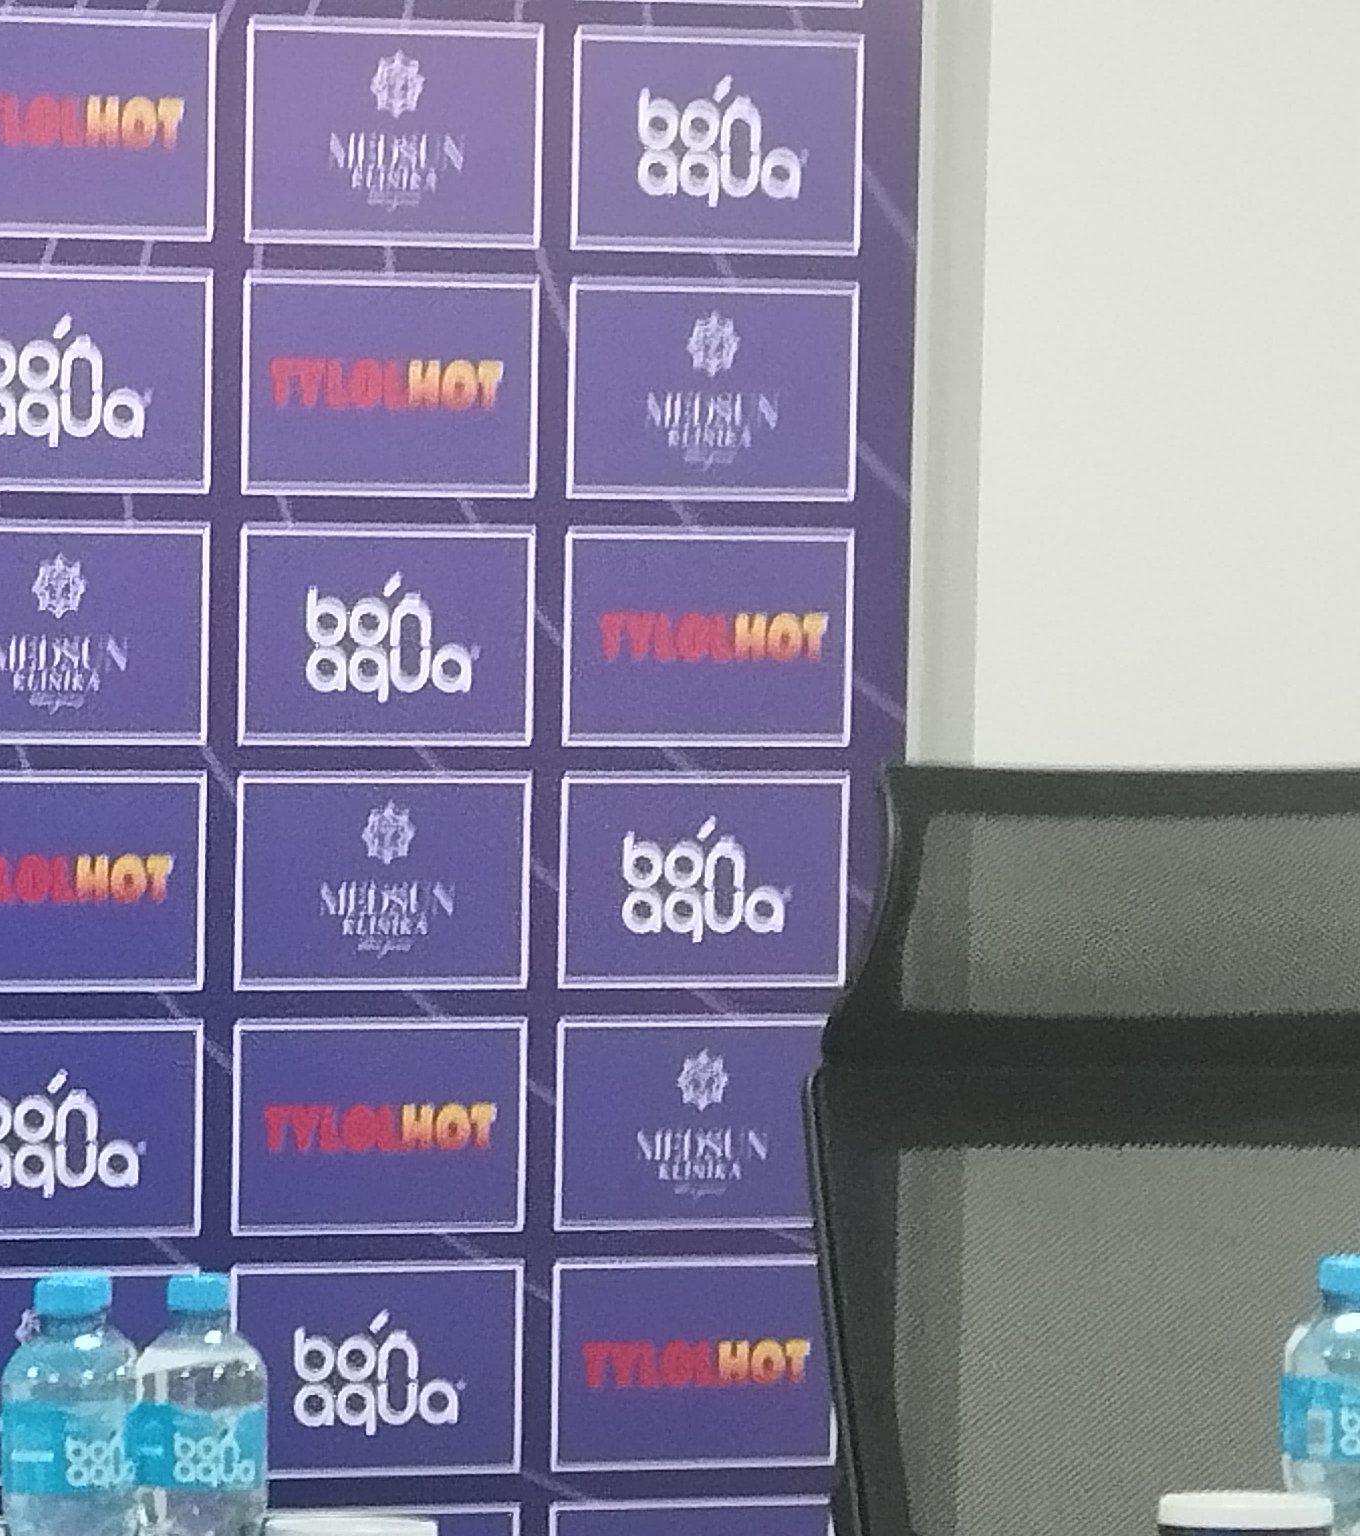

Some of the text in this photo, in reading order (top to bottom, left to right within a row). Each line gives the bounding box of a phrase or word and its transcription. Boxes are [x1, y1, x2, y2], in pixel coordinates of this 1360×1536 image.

[638, 75, 761, 151] bón
[638, 149, 803, 207] aqua
[306, 571, 431, 647] bón
[306, 646, 474, 703] aqua
[622, 816, 745, 891] bón
[622, 888, 786, 943] aqua
[294, 1309, 418, 1383] bón
[294, 1382, 461, 1435] aqua
[173, 1458, 256, 1488] aqua
